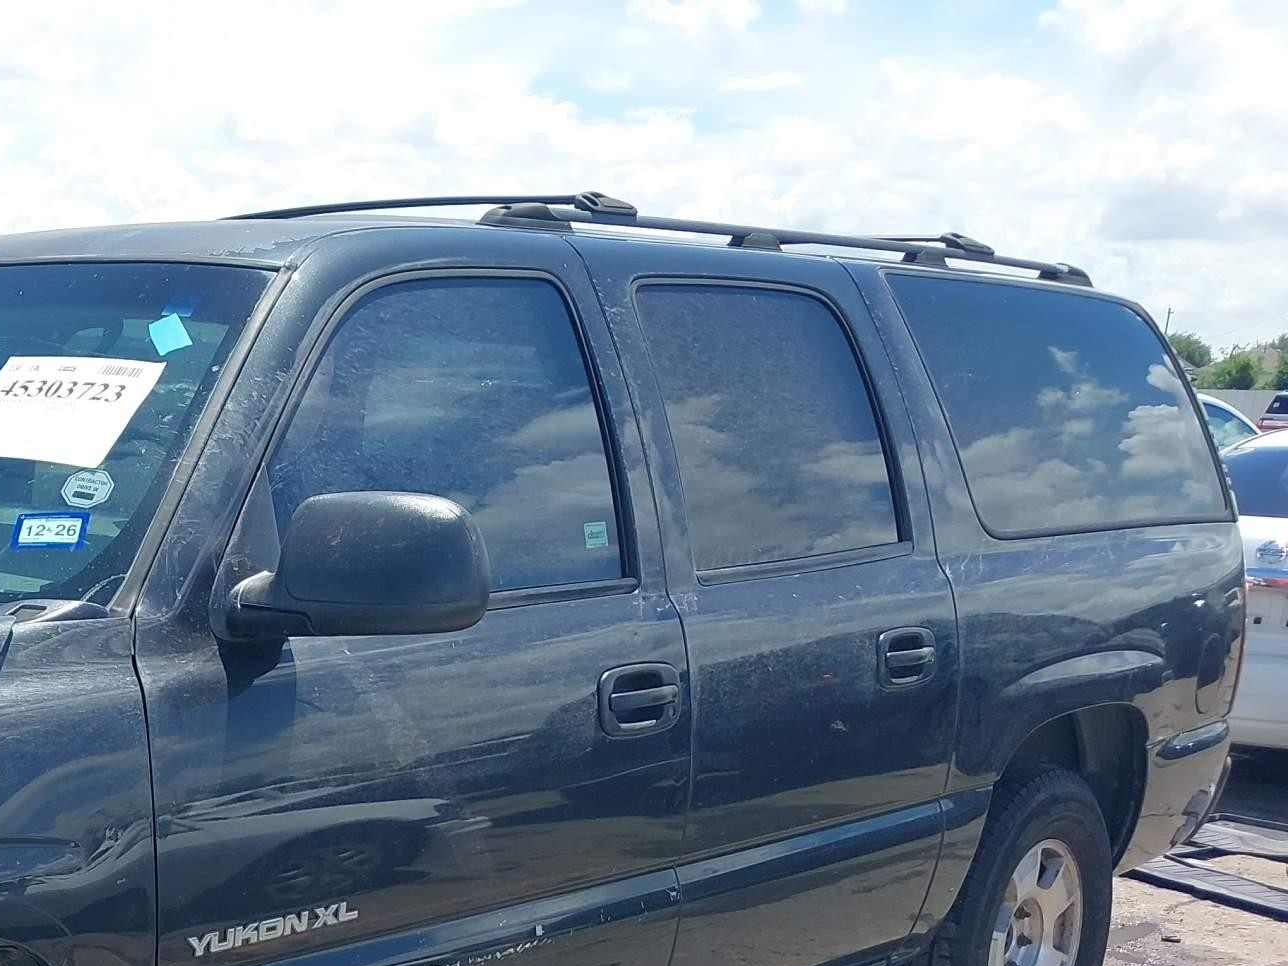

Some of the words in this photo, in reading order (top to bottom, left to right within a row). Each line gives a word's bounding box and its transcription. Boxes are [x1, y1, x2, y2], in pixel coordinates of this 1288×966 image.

[0, 380, 126, 402] 45303723
[187, 910, 309, 957] YUKON
[312, 901, 359, 929] XL
